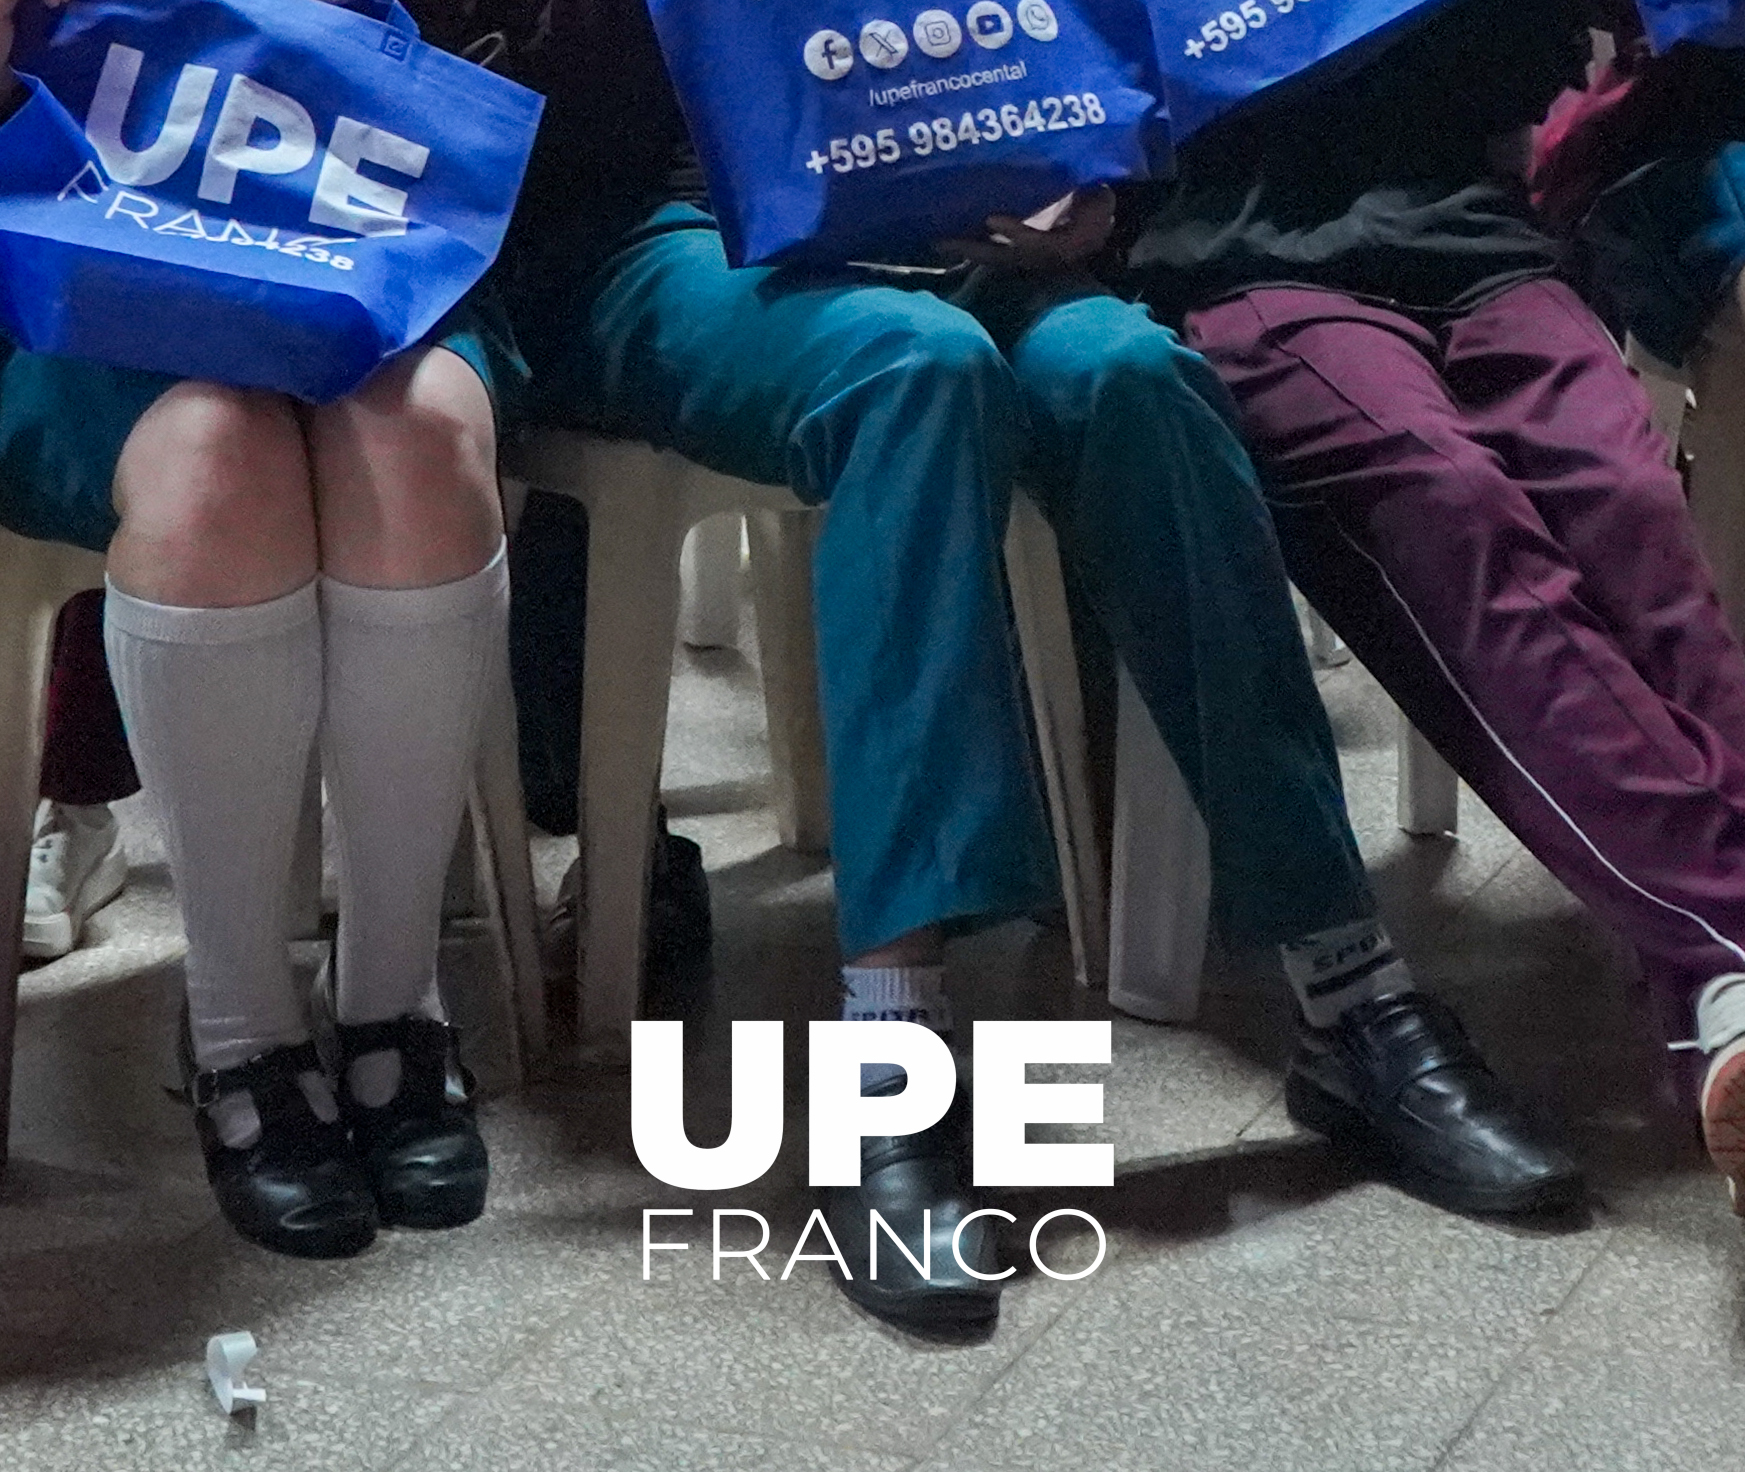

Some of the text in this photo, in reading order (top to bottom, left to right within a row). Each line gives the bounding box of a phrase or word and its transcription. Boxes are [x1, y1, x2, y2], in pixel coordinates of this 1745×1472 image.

[868, 61, 1028, 107] /upefrancocental
[85, 43, 430, 238] UPE
[806, 92, 1106, 174] +595 984364238
